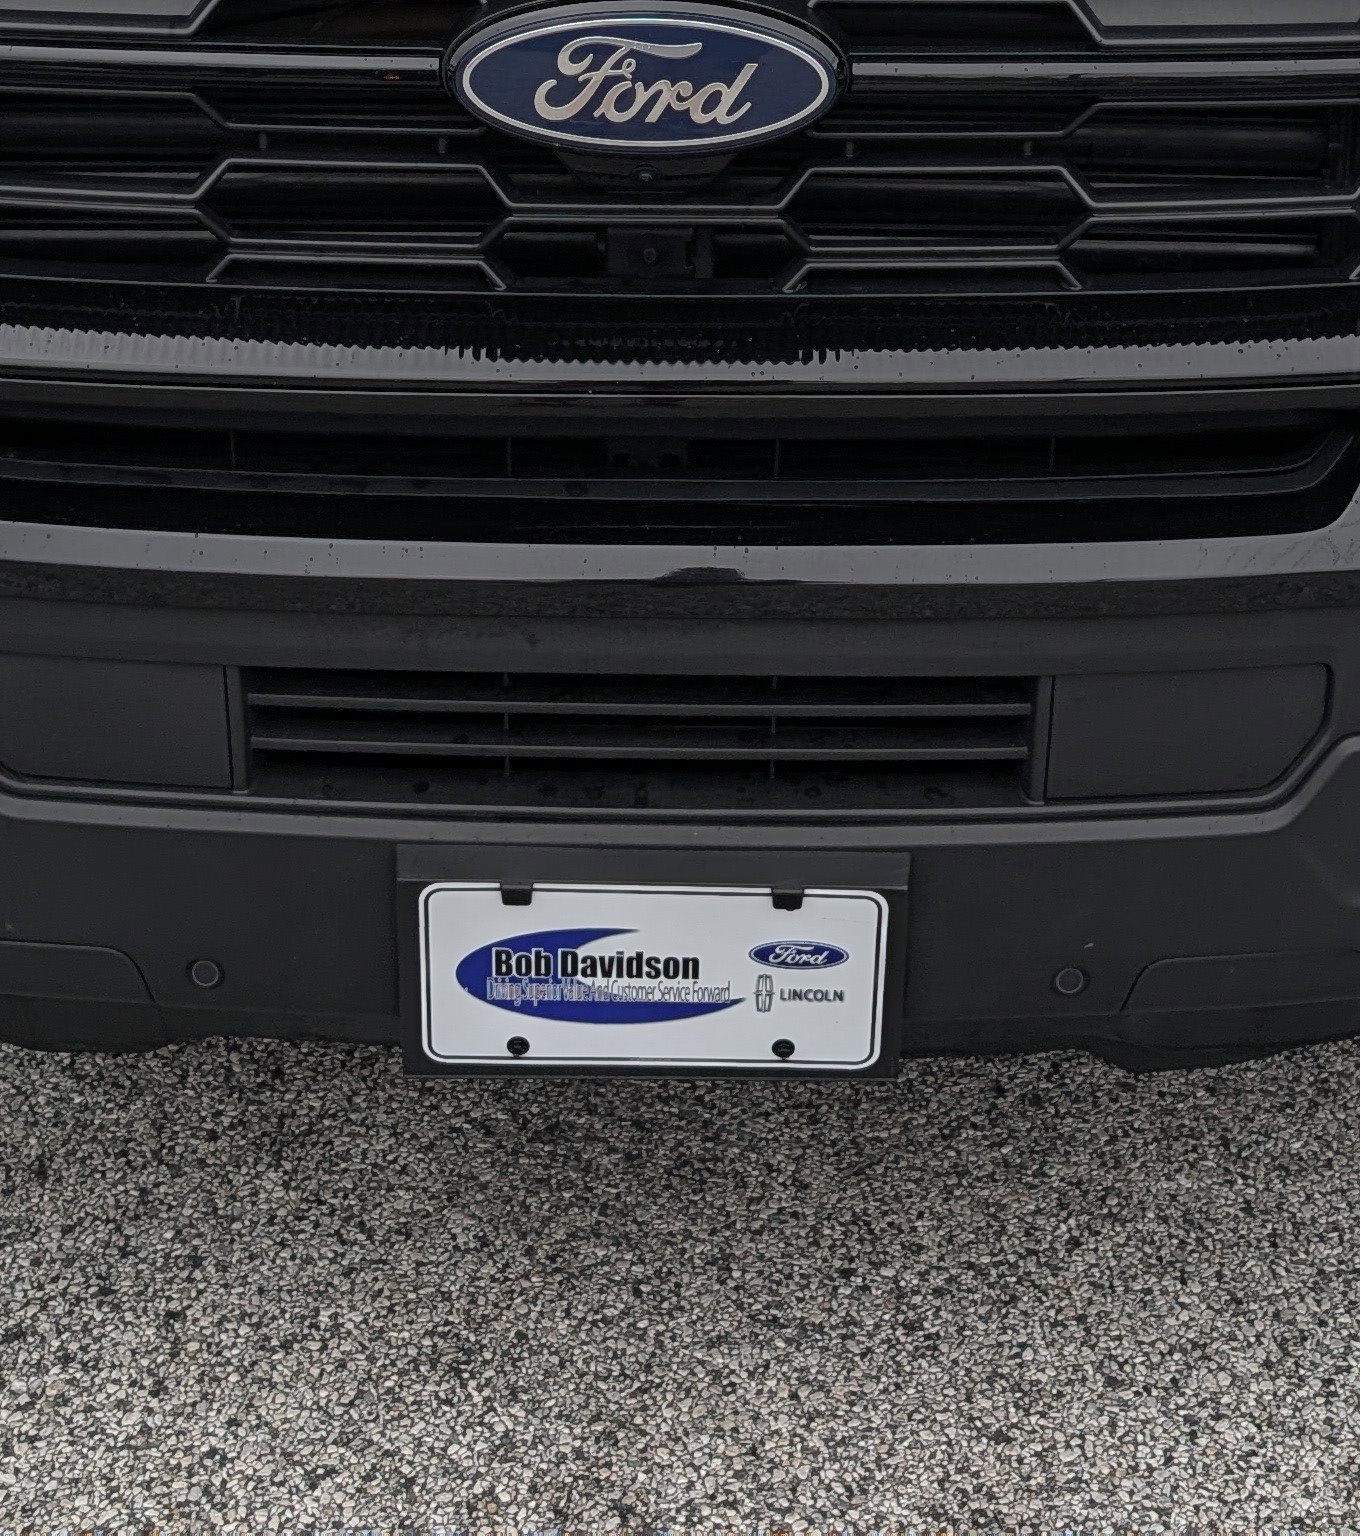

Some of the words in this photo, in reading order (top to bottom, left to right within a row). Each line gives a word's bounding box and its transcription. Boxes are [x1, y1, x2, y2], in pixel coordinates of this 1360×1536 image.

[534, 35, 758, 124] Ford
[493, 948, 552, 978] Bob
[560, 948, 700, 979] Davidson
[769, 944, 829, 965] Ford
[487, 976, 521, 1006] Driving
[521, 977, 561, 1006] Superior
[589, 979, 610, 1002] And
[611, 979, 656, 1002] Customer
[658, 980, 691, 1002] Service
[692, 980, 731, 1003] Forward
[779, 988, 845, 1002] LINCOLN
